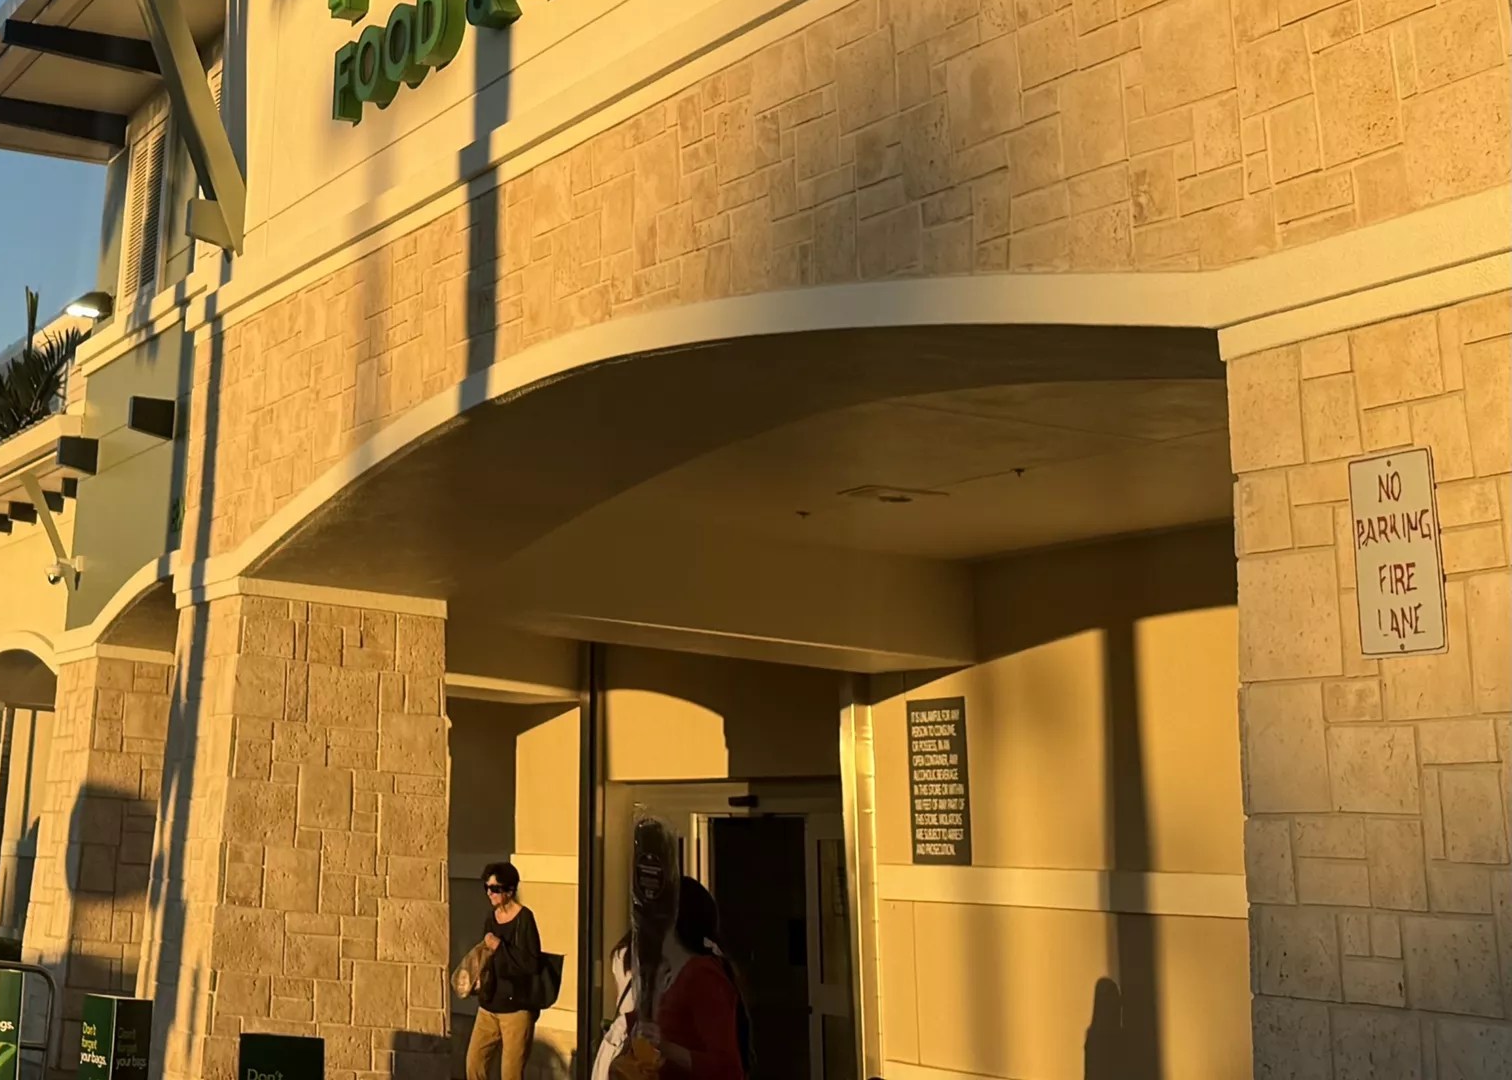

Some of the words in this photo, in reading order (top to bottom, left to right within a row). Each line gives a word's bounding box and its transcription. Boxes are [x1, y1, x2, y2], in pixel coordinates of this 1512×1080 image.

[1378, 471, 1402, 503] NO
[1356, 509, 1432, 550] PARKING
[1378, 562, 1418, 595] FIRE
[1377, 602, 1426, 639] LANE
[247, 1068, 284, 1080] Don't
